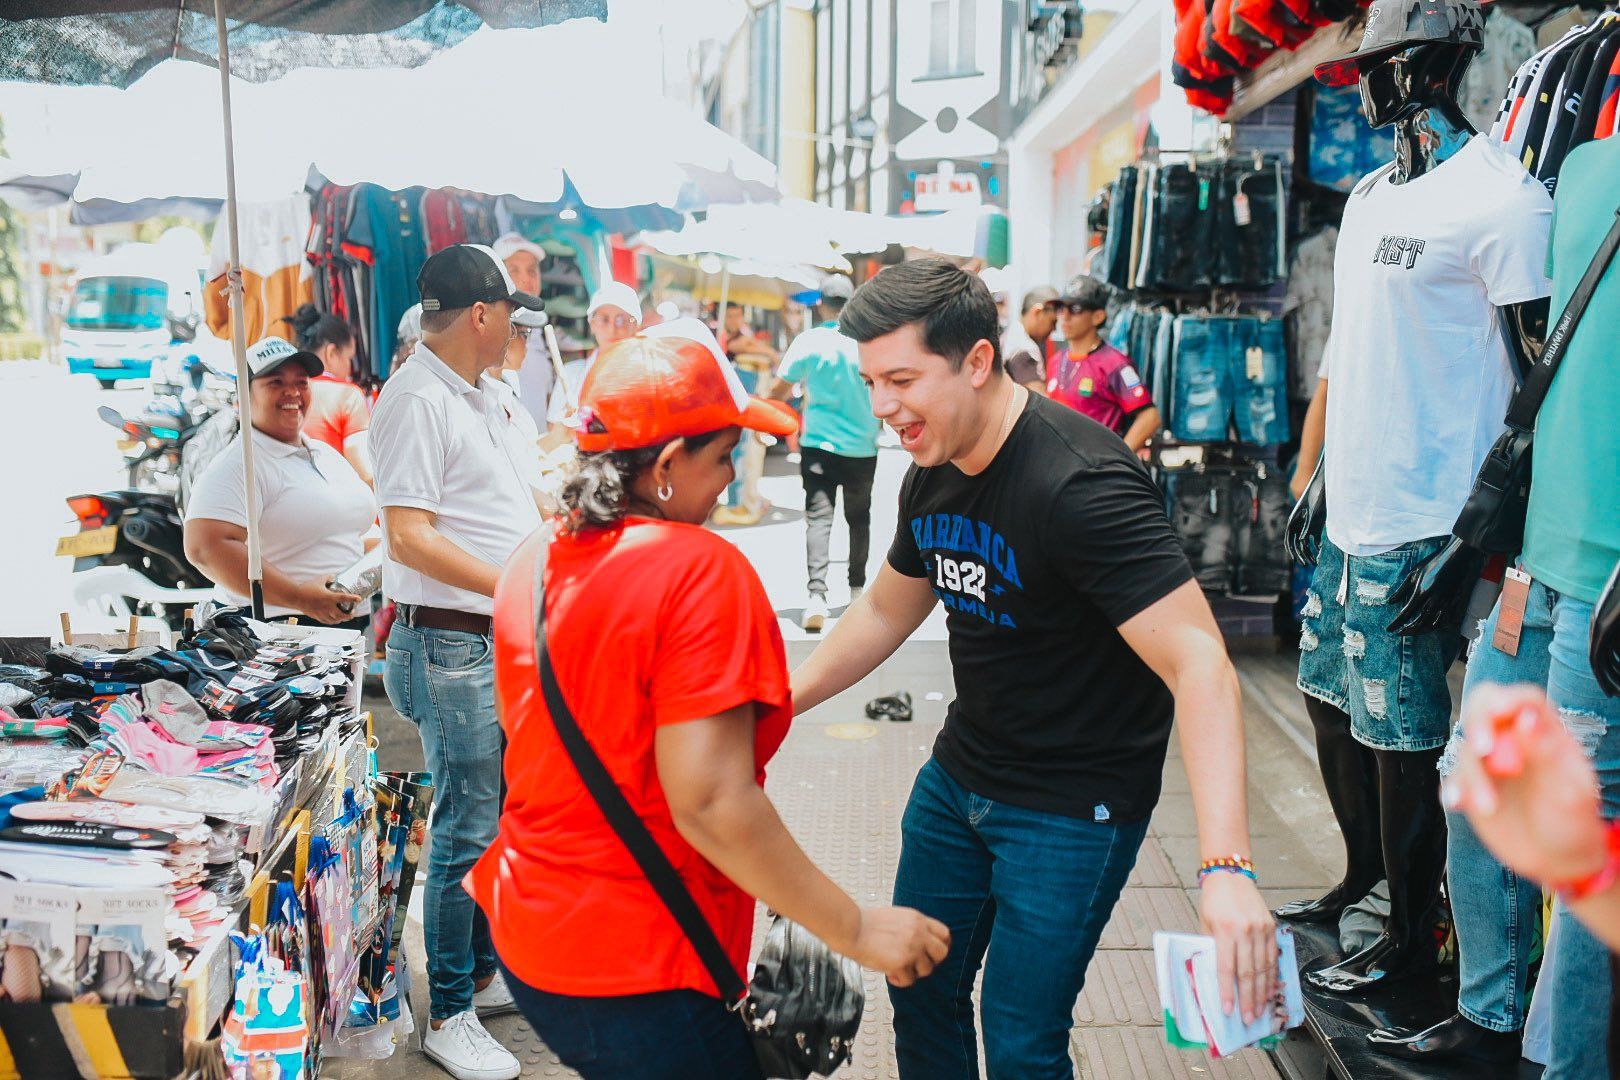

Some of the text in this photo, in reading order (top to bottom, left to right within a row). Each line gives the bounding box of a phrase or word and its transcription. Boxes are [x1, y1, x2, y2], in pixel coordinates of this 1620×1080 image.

[1373, 235, 1426, 270] MST
[1542, 330, 1564, 366] PANTHER
[911, 513, 1024, 591] BARRANCA
[935, 553, 987, 603] 1922
